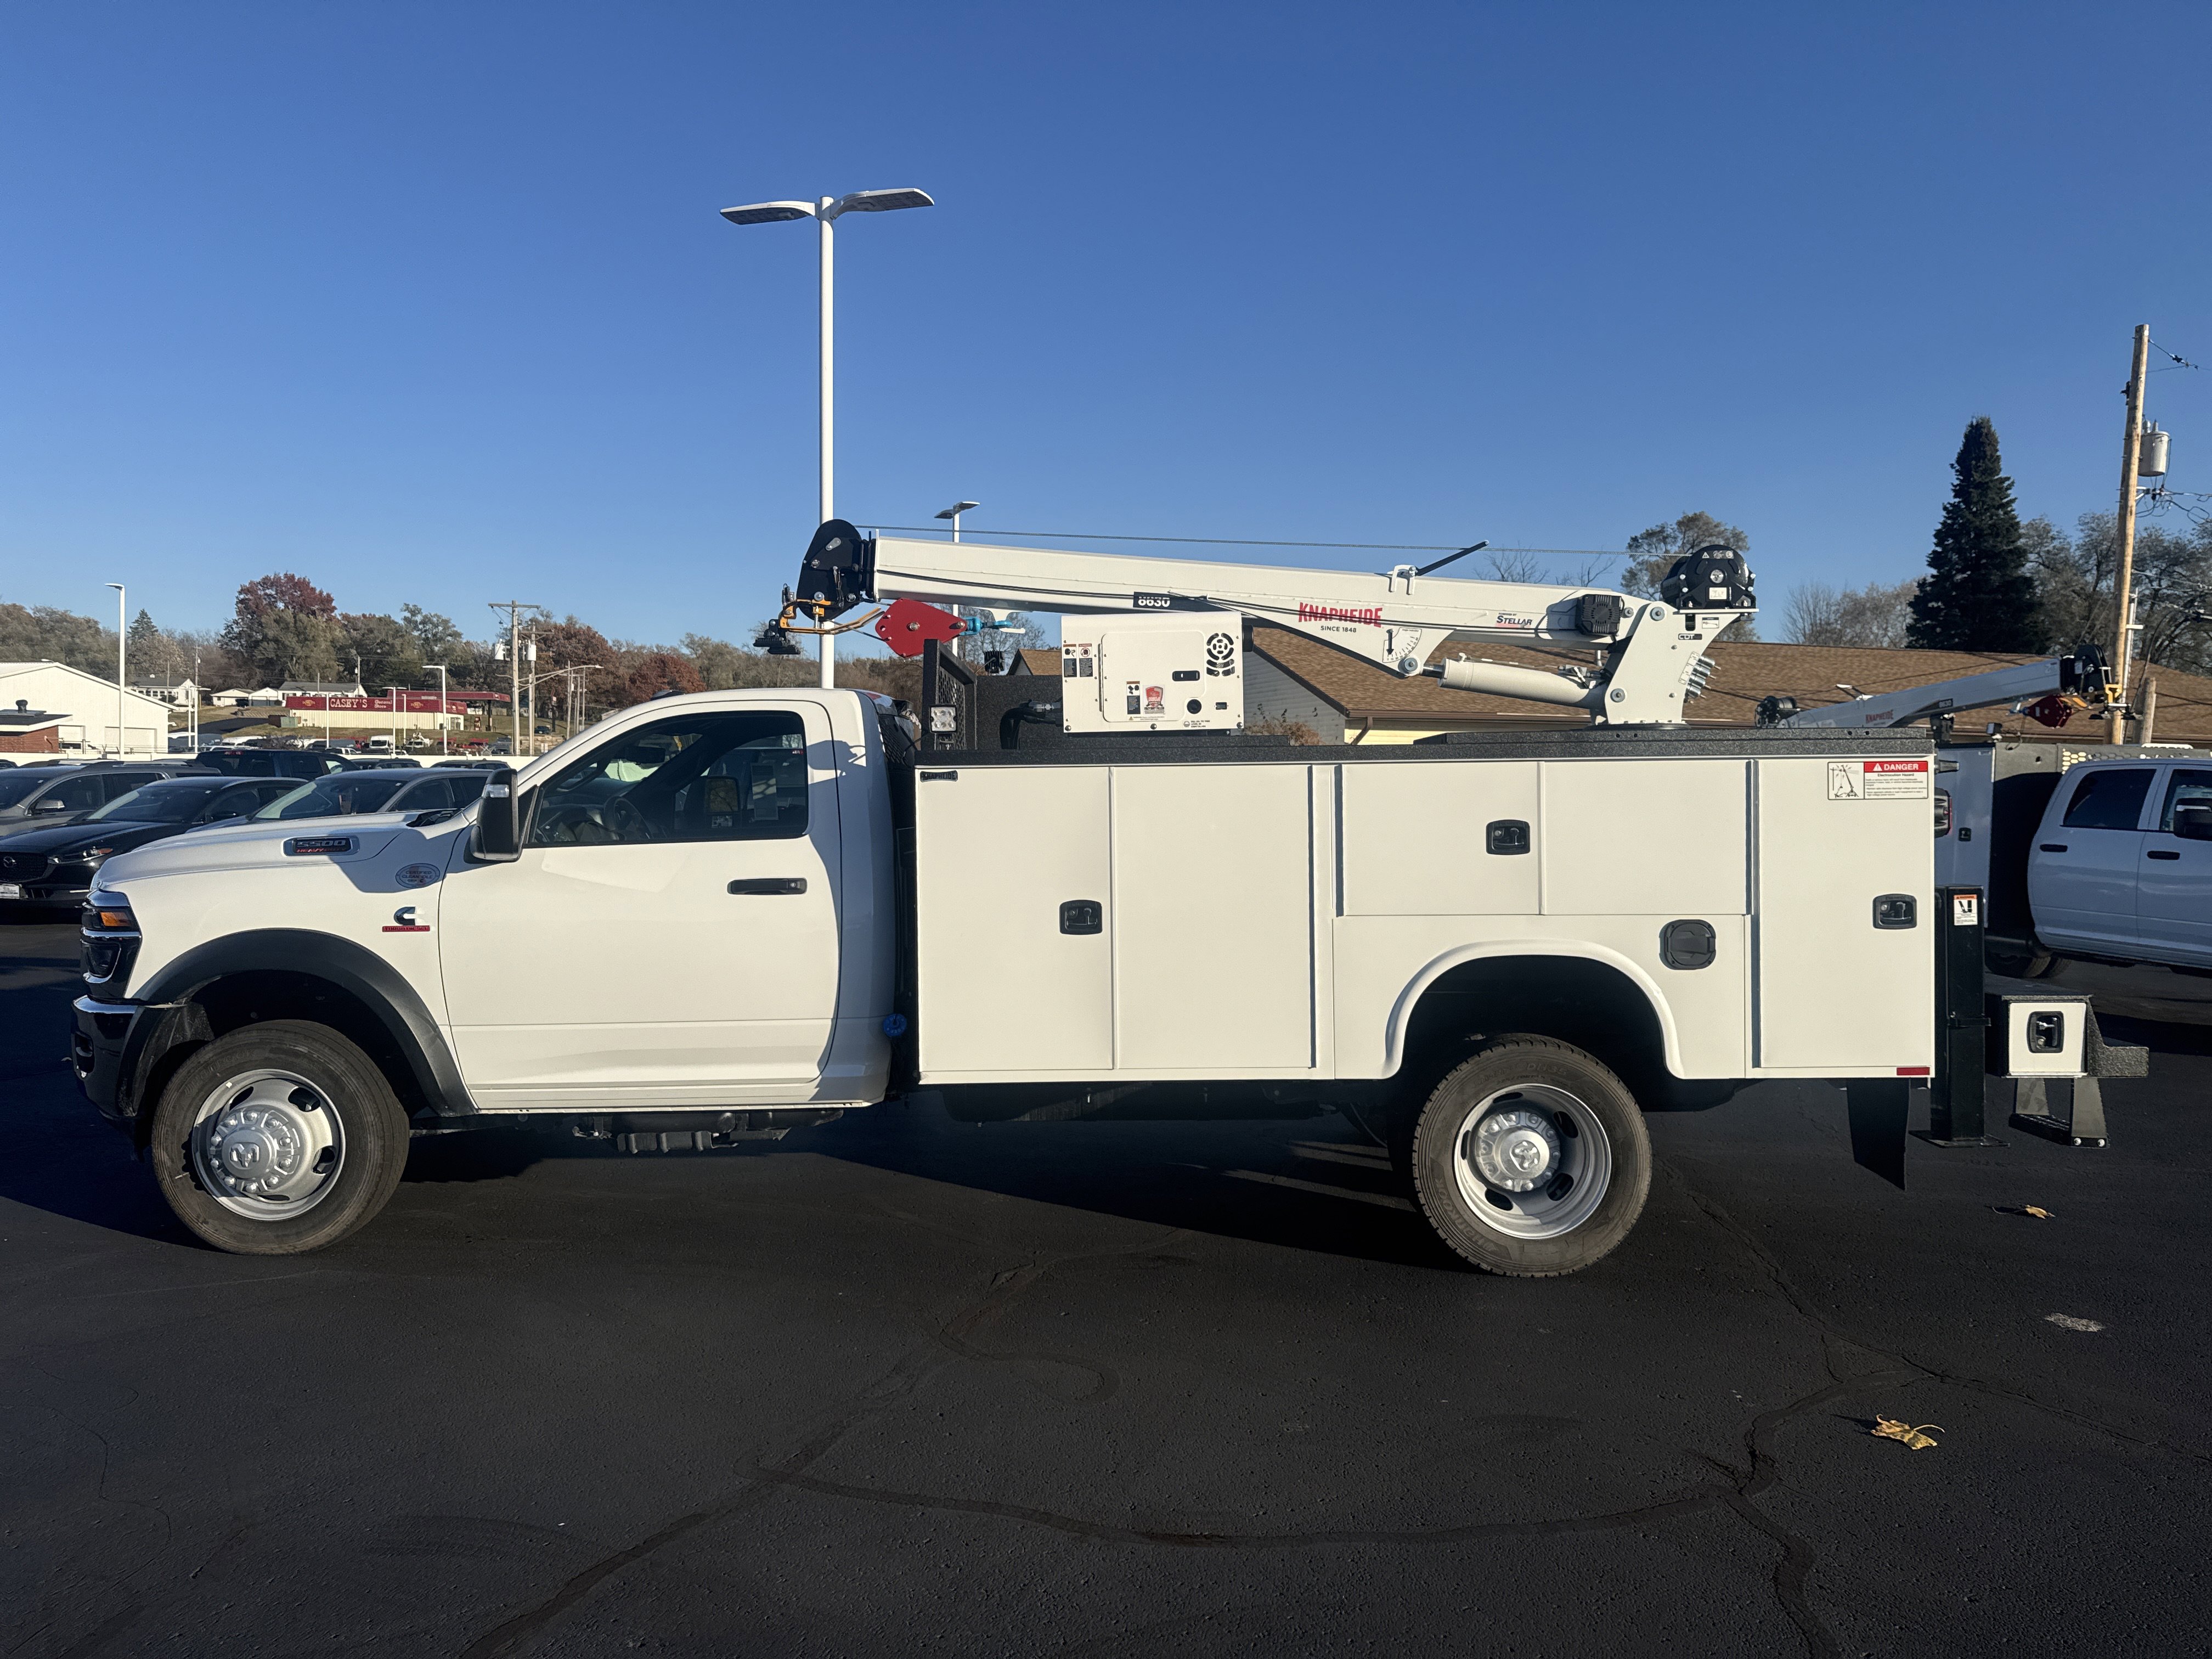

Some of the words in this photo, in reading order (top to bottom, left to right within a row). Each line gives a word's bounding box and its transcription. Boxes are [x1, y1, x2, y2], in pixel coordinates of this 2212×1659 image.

[1299, 602, 1383, 628] KNAPHEIDE
[1497, 615, 1532, 625] STELLAR
[330, 698, 368, 708] CASEY'S
